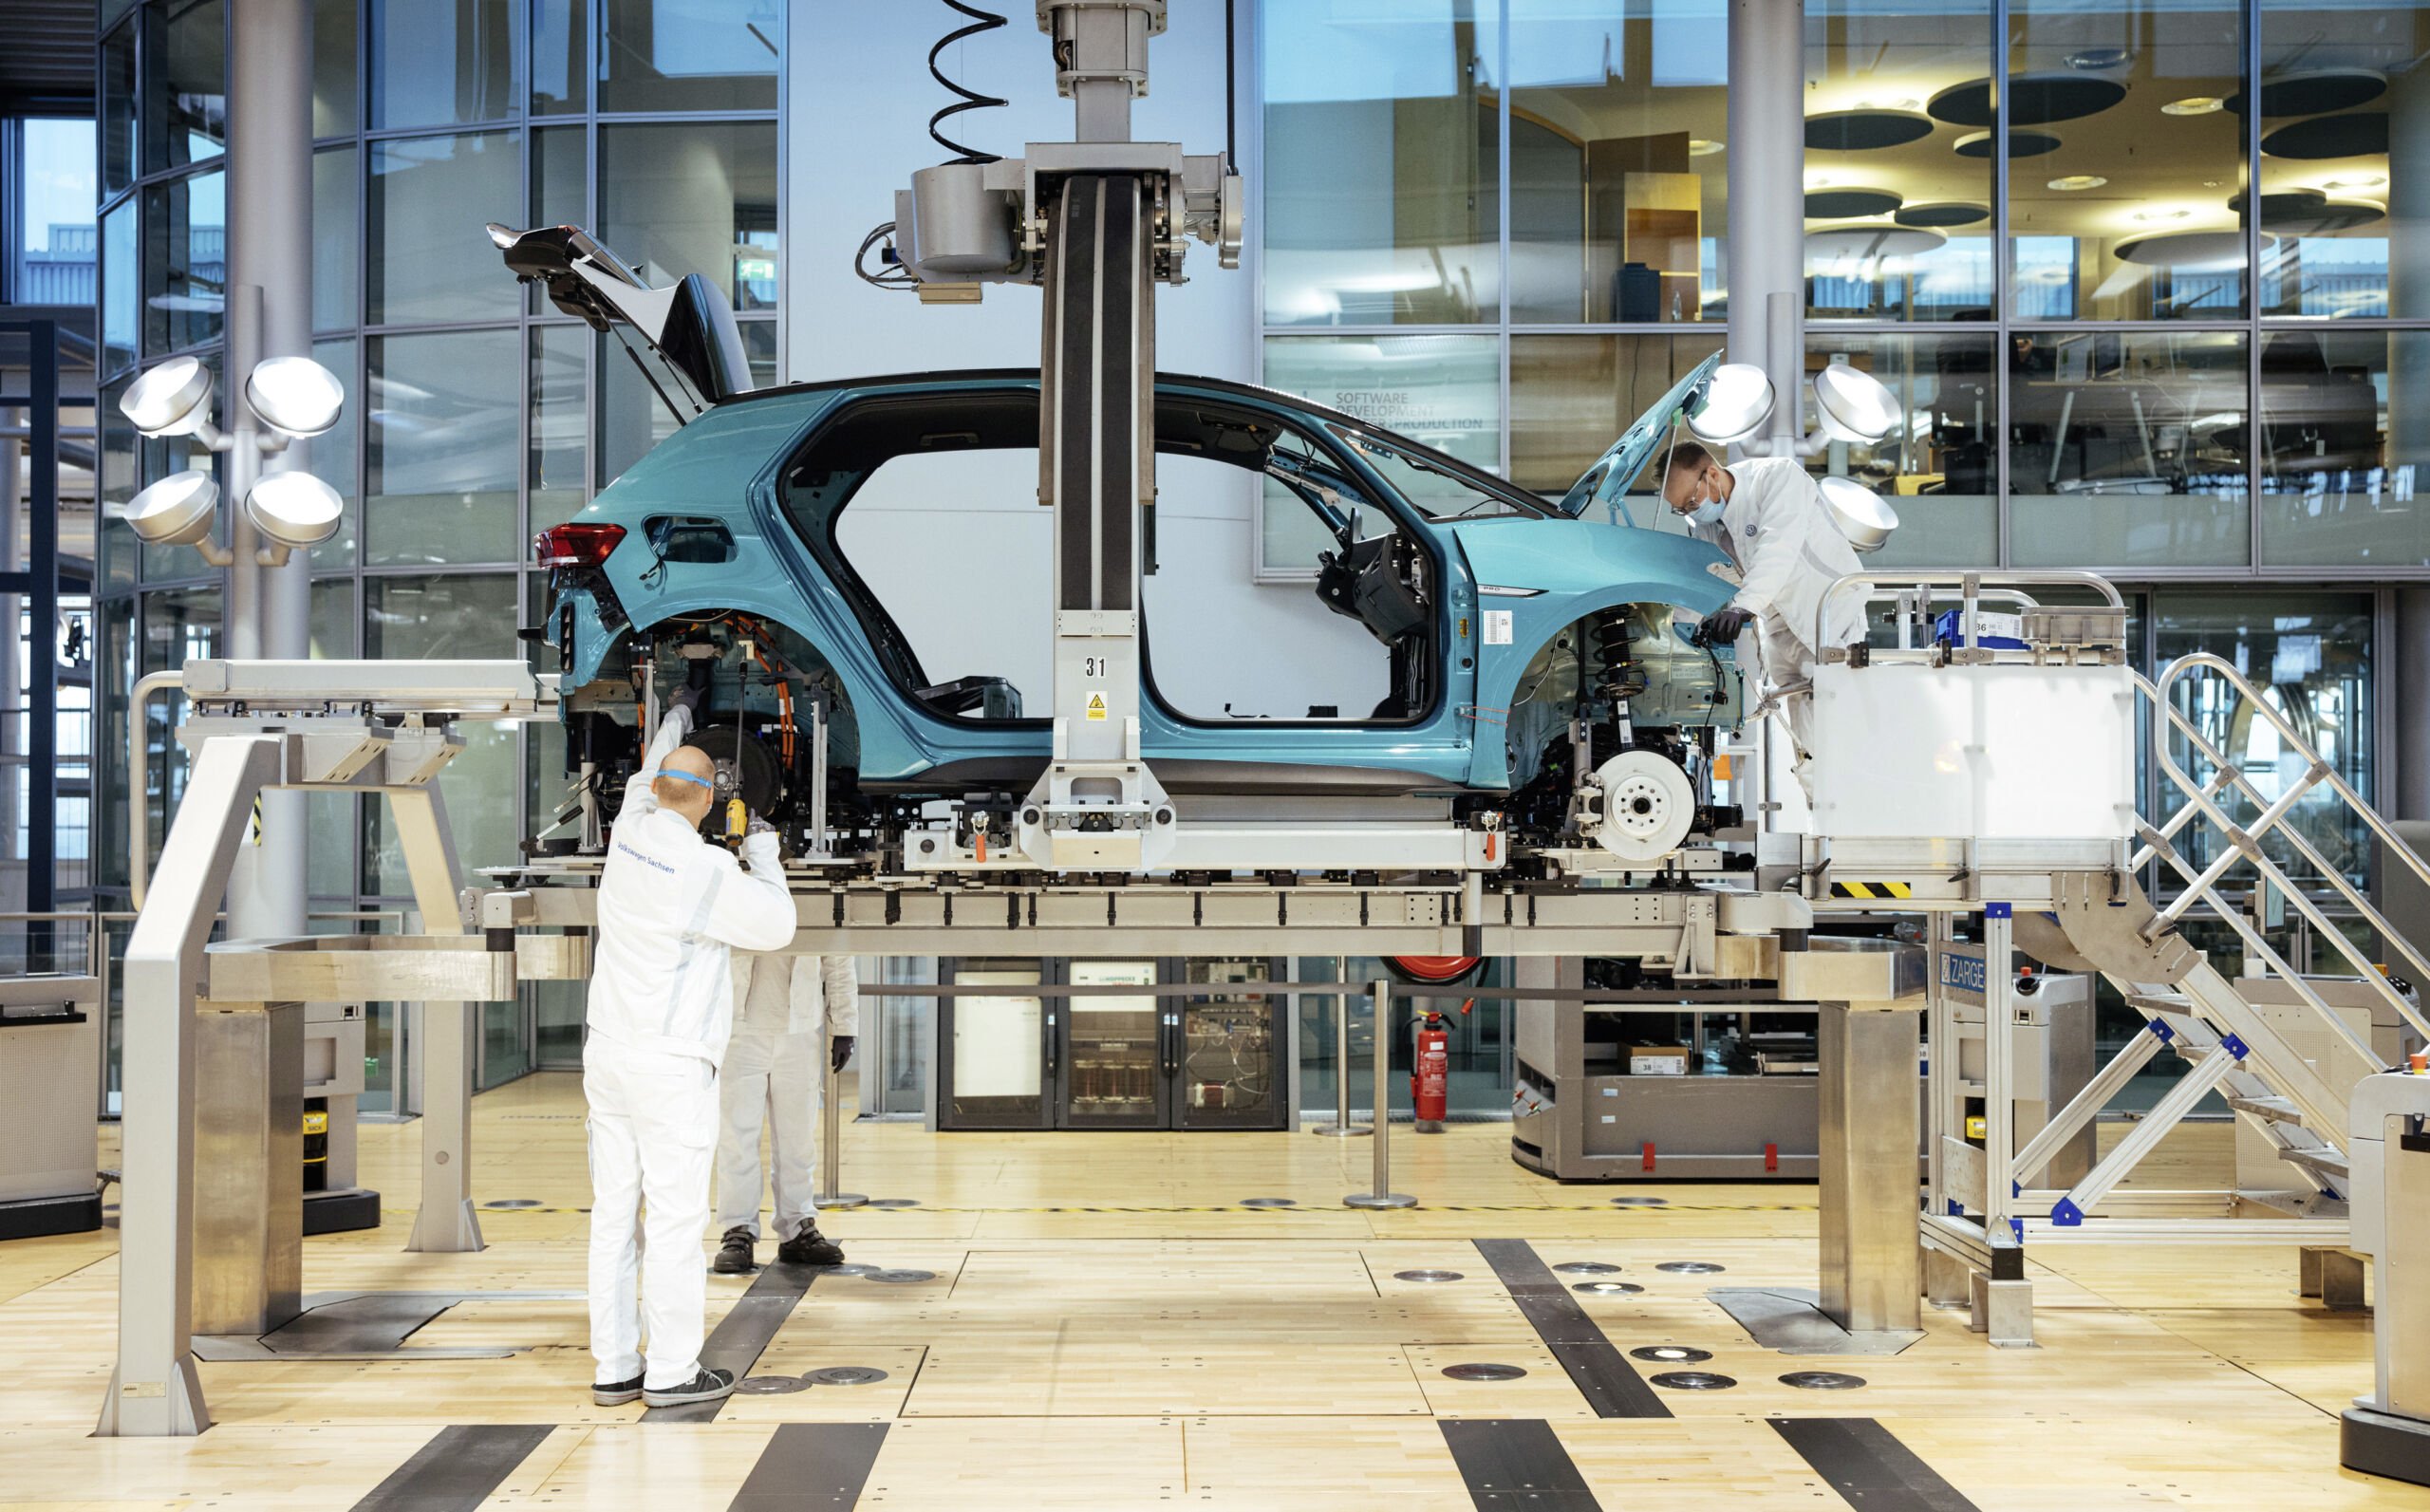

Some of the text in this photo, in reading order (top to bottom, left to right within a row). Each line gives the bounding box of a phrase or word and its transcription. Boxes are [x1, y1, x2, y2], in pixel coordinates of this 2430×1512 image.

[1336, 392, 1409, 404] SOFTWARE
[617, 841, 675, 874] Volkswagen Sachsen
[1952, 958, 1984, 987] ZARGE
